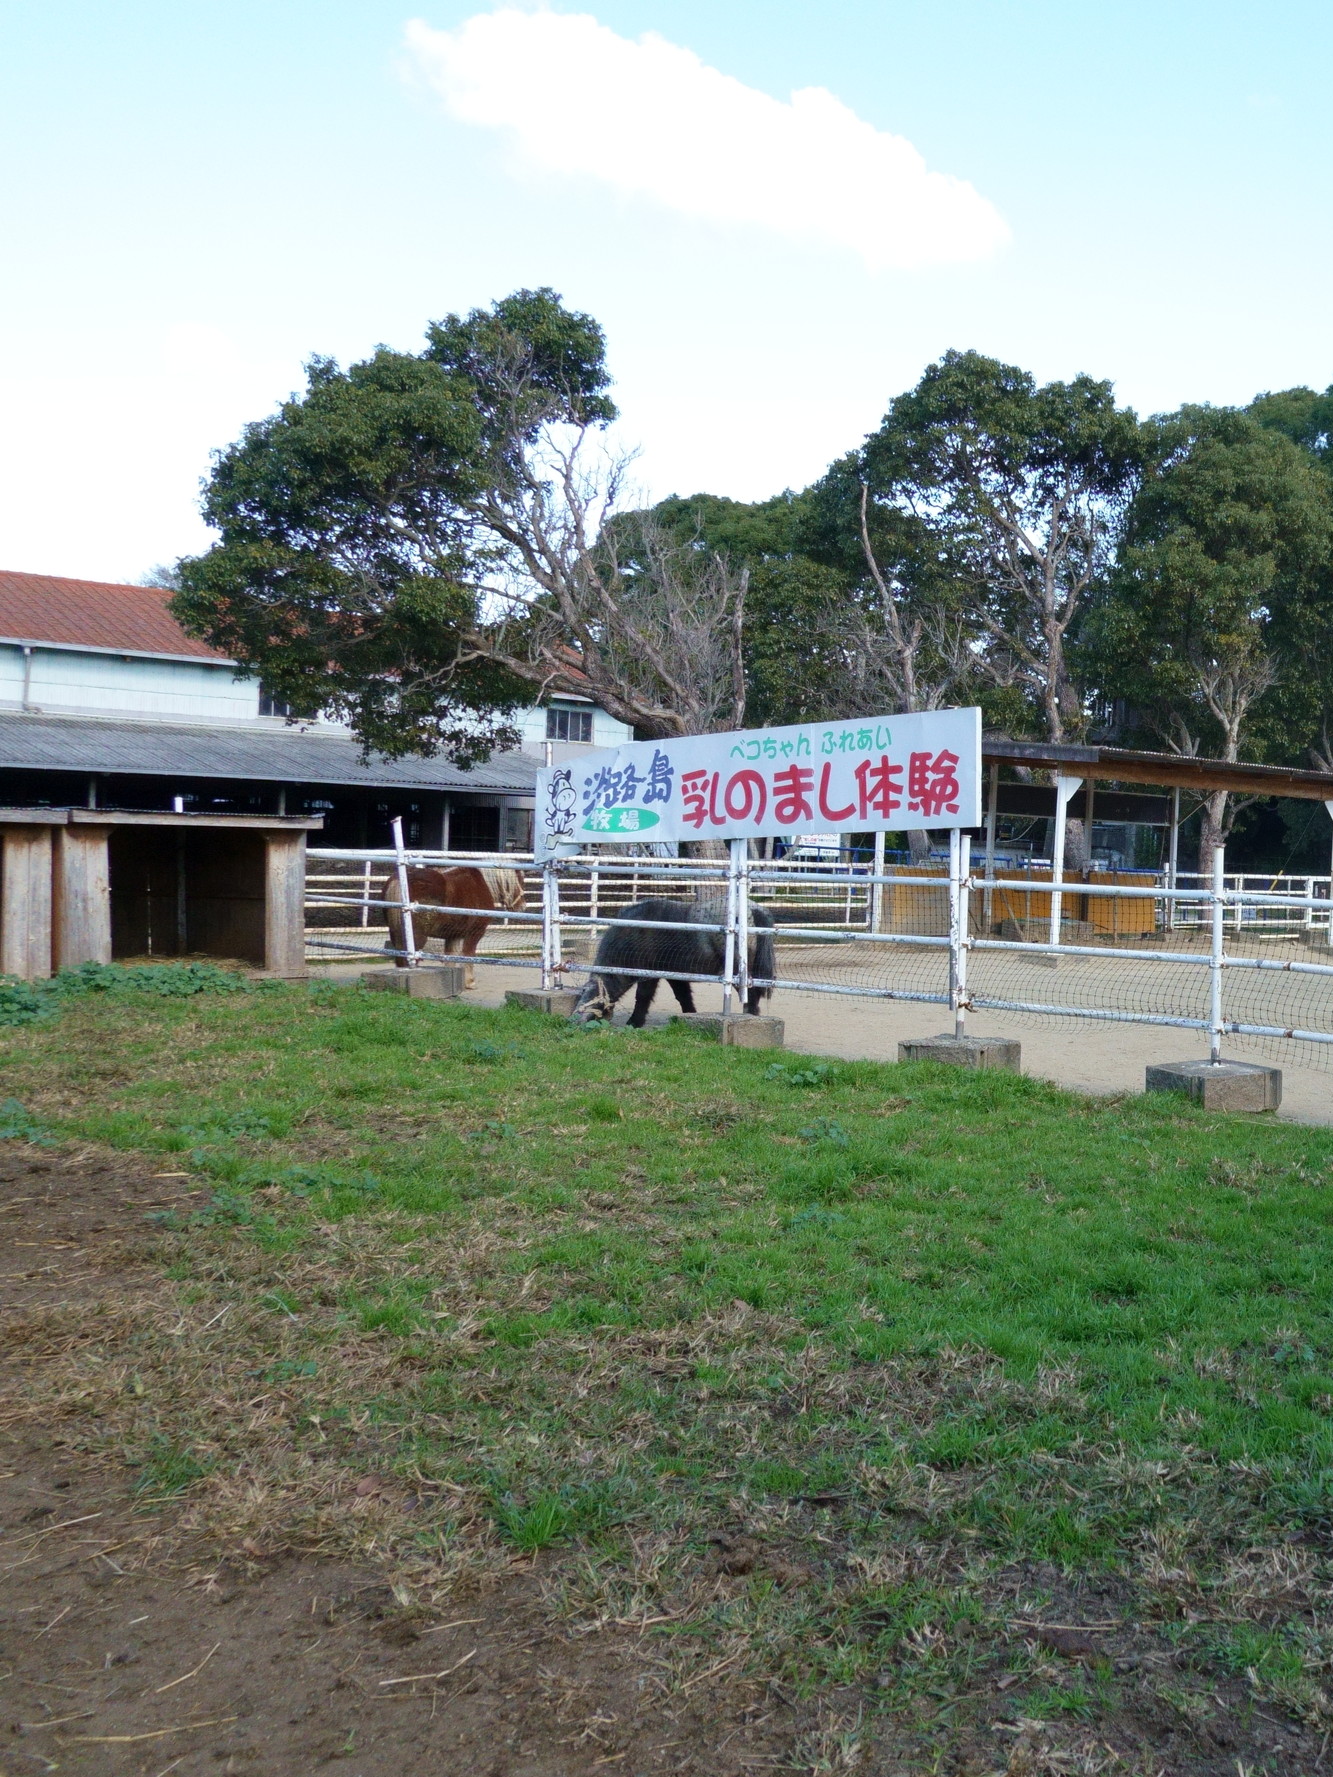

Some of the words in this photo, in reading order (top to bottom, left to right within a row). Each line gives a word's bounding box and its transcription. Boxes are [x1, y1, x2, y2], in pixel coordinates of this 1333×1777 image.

[730, 733, 812, 761] ベコちゃん
[821, 725, 892, 755] ふれあい
[582, 749, 675, 817] 淡路島
[681, 748, 961, 830] 乳のまし体験
[590, 809, 640, 830] 牧場
